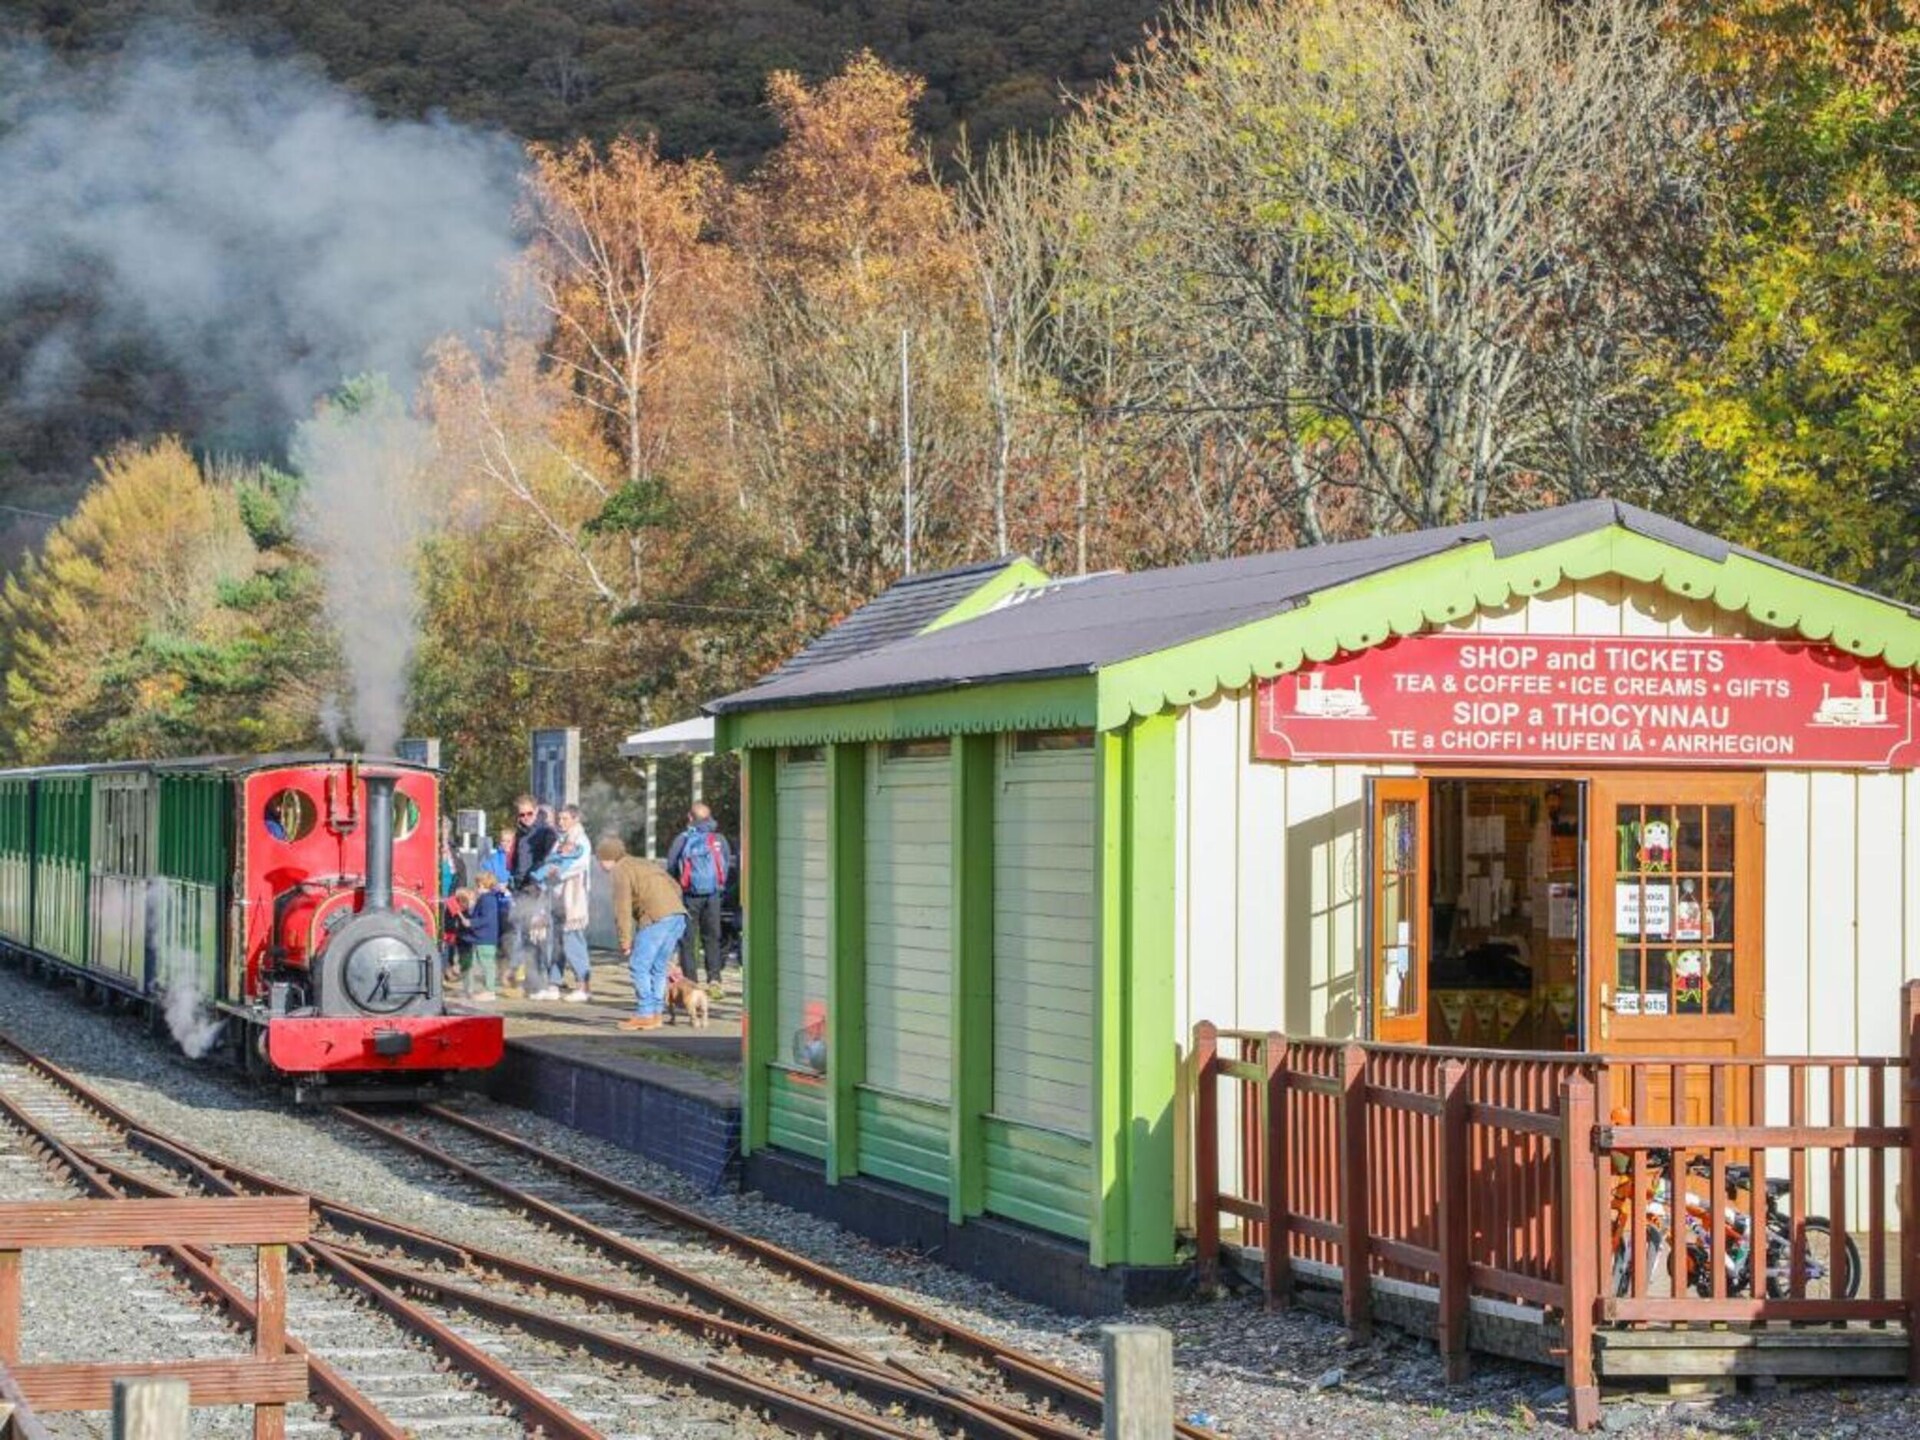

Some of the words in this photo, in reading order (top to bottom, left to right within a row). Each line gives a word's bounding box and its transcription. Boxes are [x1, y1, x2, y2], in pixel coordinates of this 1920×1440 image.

[1459, 645, 1538, 669] SHOP
[1546, 647, 1596, 670] and
[1605, 648, 1724, 672] TICKETS
[1393, 673, 1436, 692] TEA
[1441, 674, 1457, 693] &
[1464, 675, 1552, 693] COFFEE
[1571, 677, 1607, 694] ICE
[1614, 677, 1708, 697] CREAMS
[1726, 679, 1790, 697] GIFTS
[1453, 701, 1520, 726] SIOP
[1527, 706, 1543, 726] a
[1552, 702, 1730, 729] THOCYNNAU
[1388, 730, 1417, 748] TE
[1422, 734, 1435, 749] a
[1440, 731, 1522, 749] CHOFFI
[1542, 732, 1615, 751] HUFEN
[1623, 728, 1644, 751] IÂ
[1660, 734, 1794, 754] ANRHEGION
